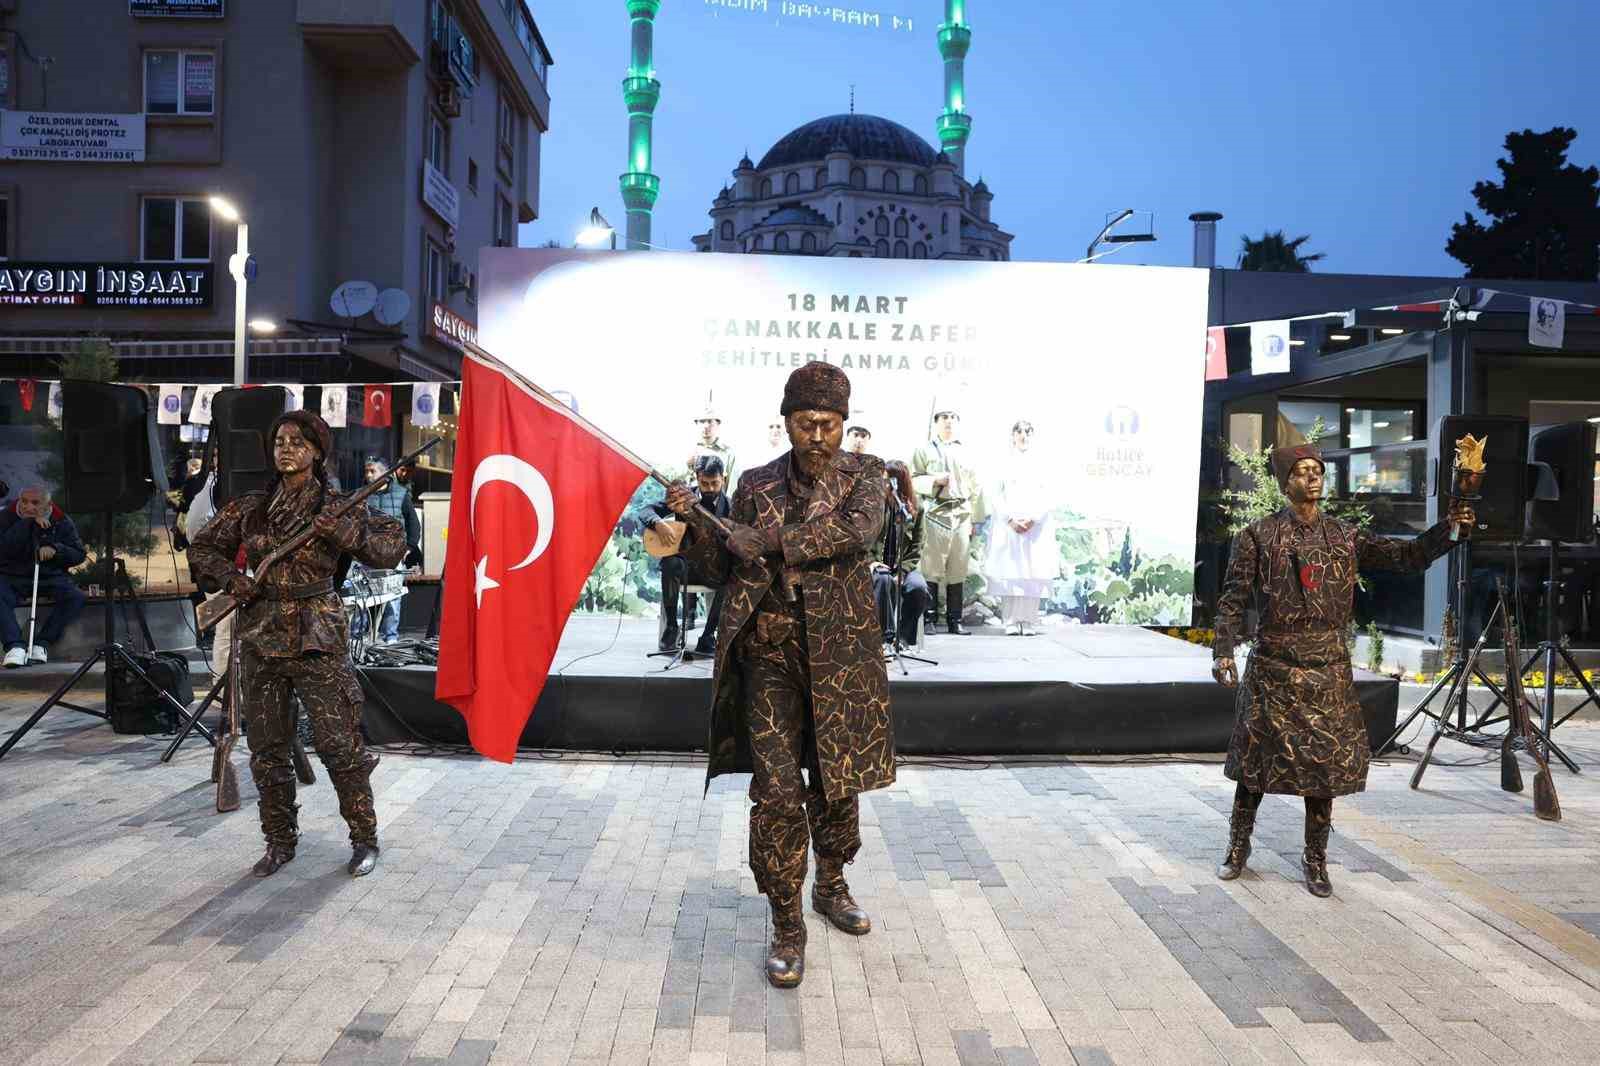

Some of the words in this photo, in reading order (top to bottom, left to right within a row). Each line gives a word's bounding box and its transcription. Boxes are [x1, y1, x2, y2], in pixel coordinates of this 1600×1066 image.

[28, 114, 51, 125] ÖZEL
[52, 117, 83, 126] DORUK
[85, 118, 119, 127] DENTAL
[20, 126, 39, 136] ÇOK
[40, 127, 74, 138] AMAÇLI
[75, 127, 89, 138] DİŞ
[91, 128, 127, 137] PROTEZ
[39, 138, 108, 147] LABORATUVARI
[96, 266, 204, 295] İNŞAAT
[0, 294, 40, 304] TİBAT
[788, 293, 816, 312] 18
[831, 294, 908, 314] MART
[704, 319, 877, 341] ÇANAKKALE
[841, 354, 911, 371] ANMA
